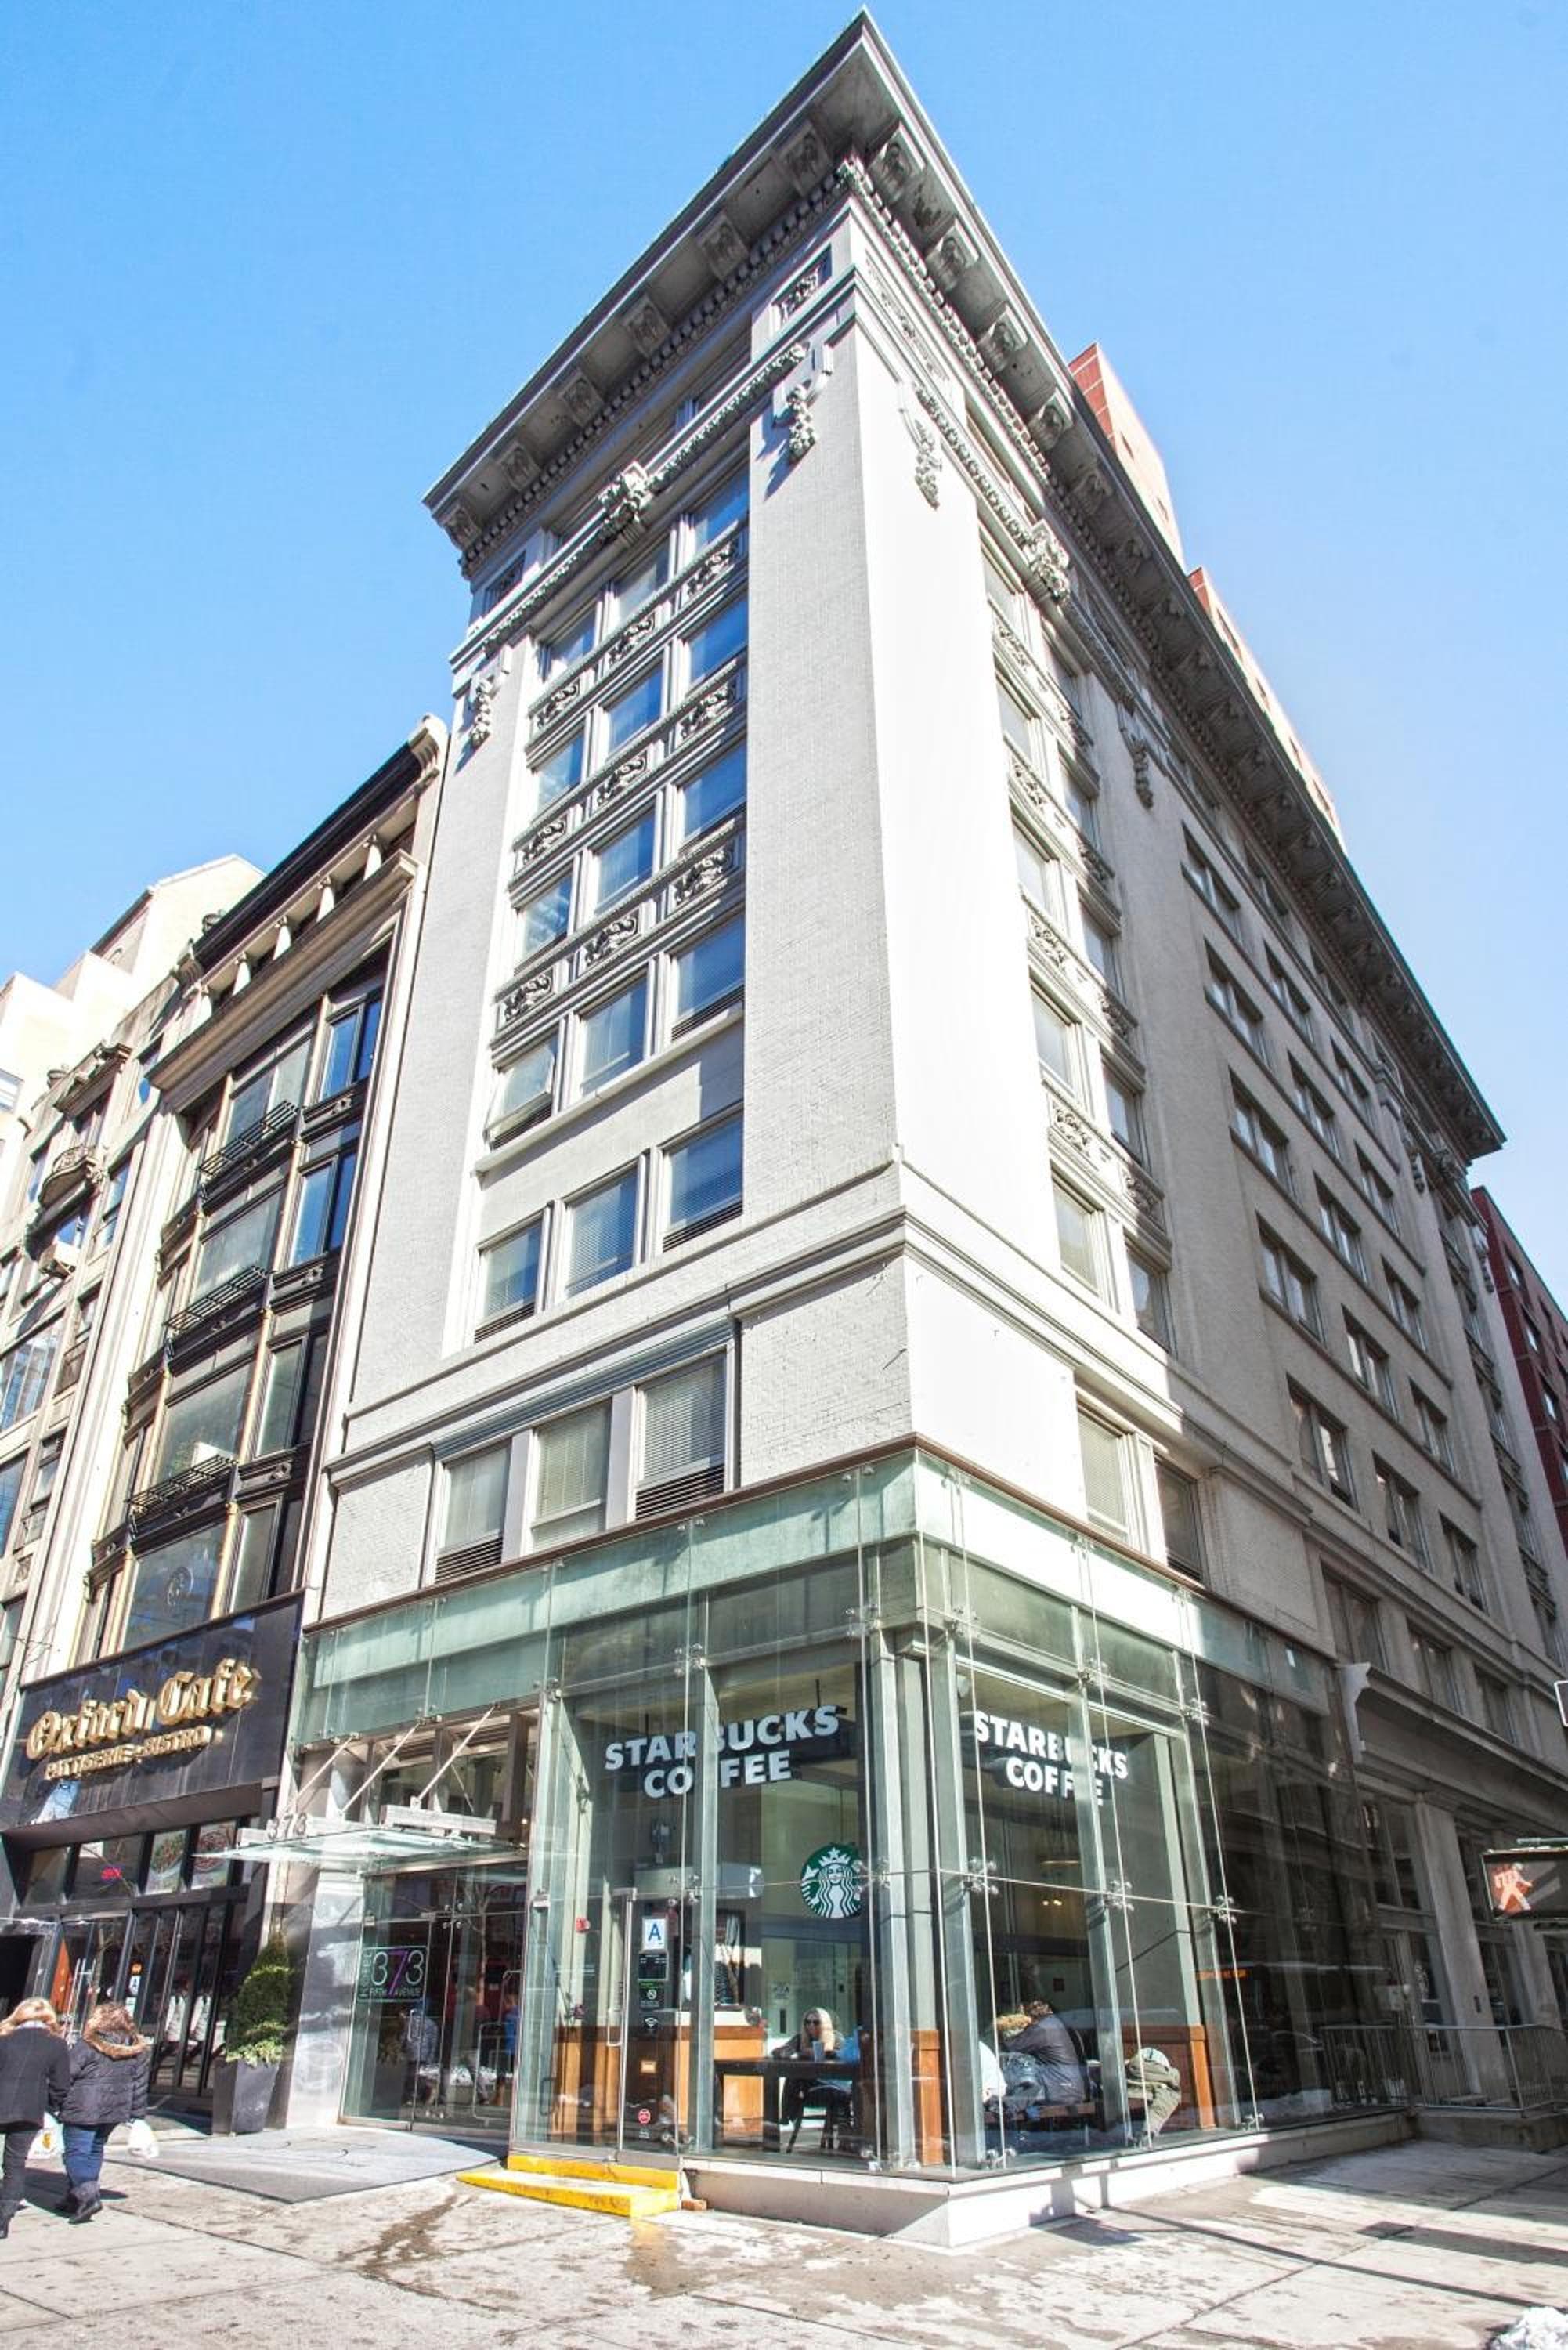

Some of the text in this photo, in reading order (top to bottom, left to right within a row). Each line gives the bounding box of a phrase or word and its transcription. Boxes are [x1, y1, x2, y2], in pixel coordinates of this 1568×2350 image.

[143, 1725, 213, 1758] BISTRO
[644, 1749, 793, 1799] COFEE
[1006, 1756, 1104, 1806] COFFE
[648, 1923, 662, 1941] A
[371, 1950, 424, 1995] 373
